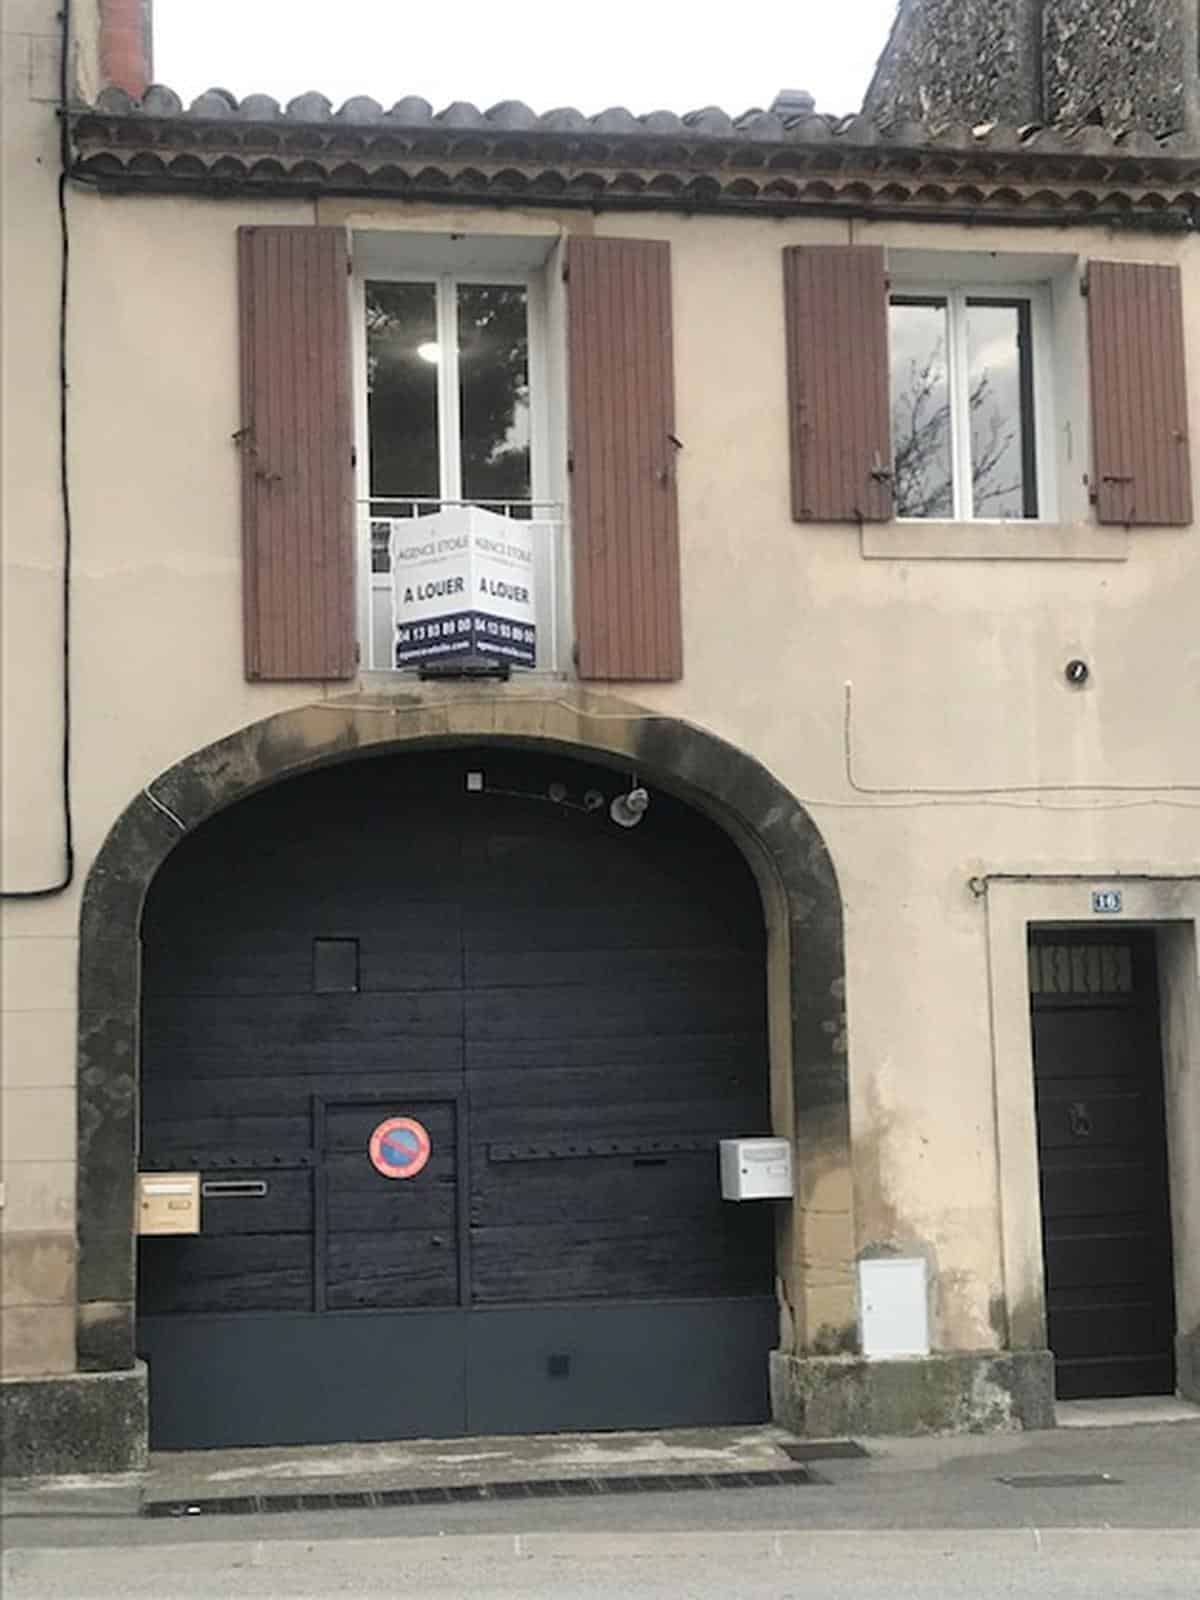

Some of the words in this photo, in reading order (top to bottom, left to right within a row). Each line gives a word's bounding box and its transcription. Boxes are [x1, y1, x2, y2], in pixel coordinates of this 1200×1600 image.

[404, 587, 414, 603] A
[416, 576, 464, 601] LOUER
[480, 577, 488, 594] A
[489, 580, 529, 603] LOUER
